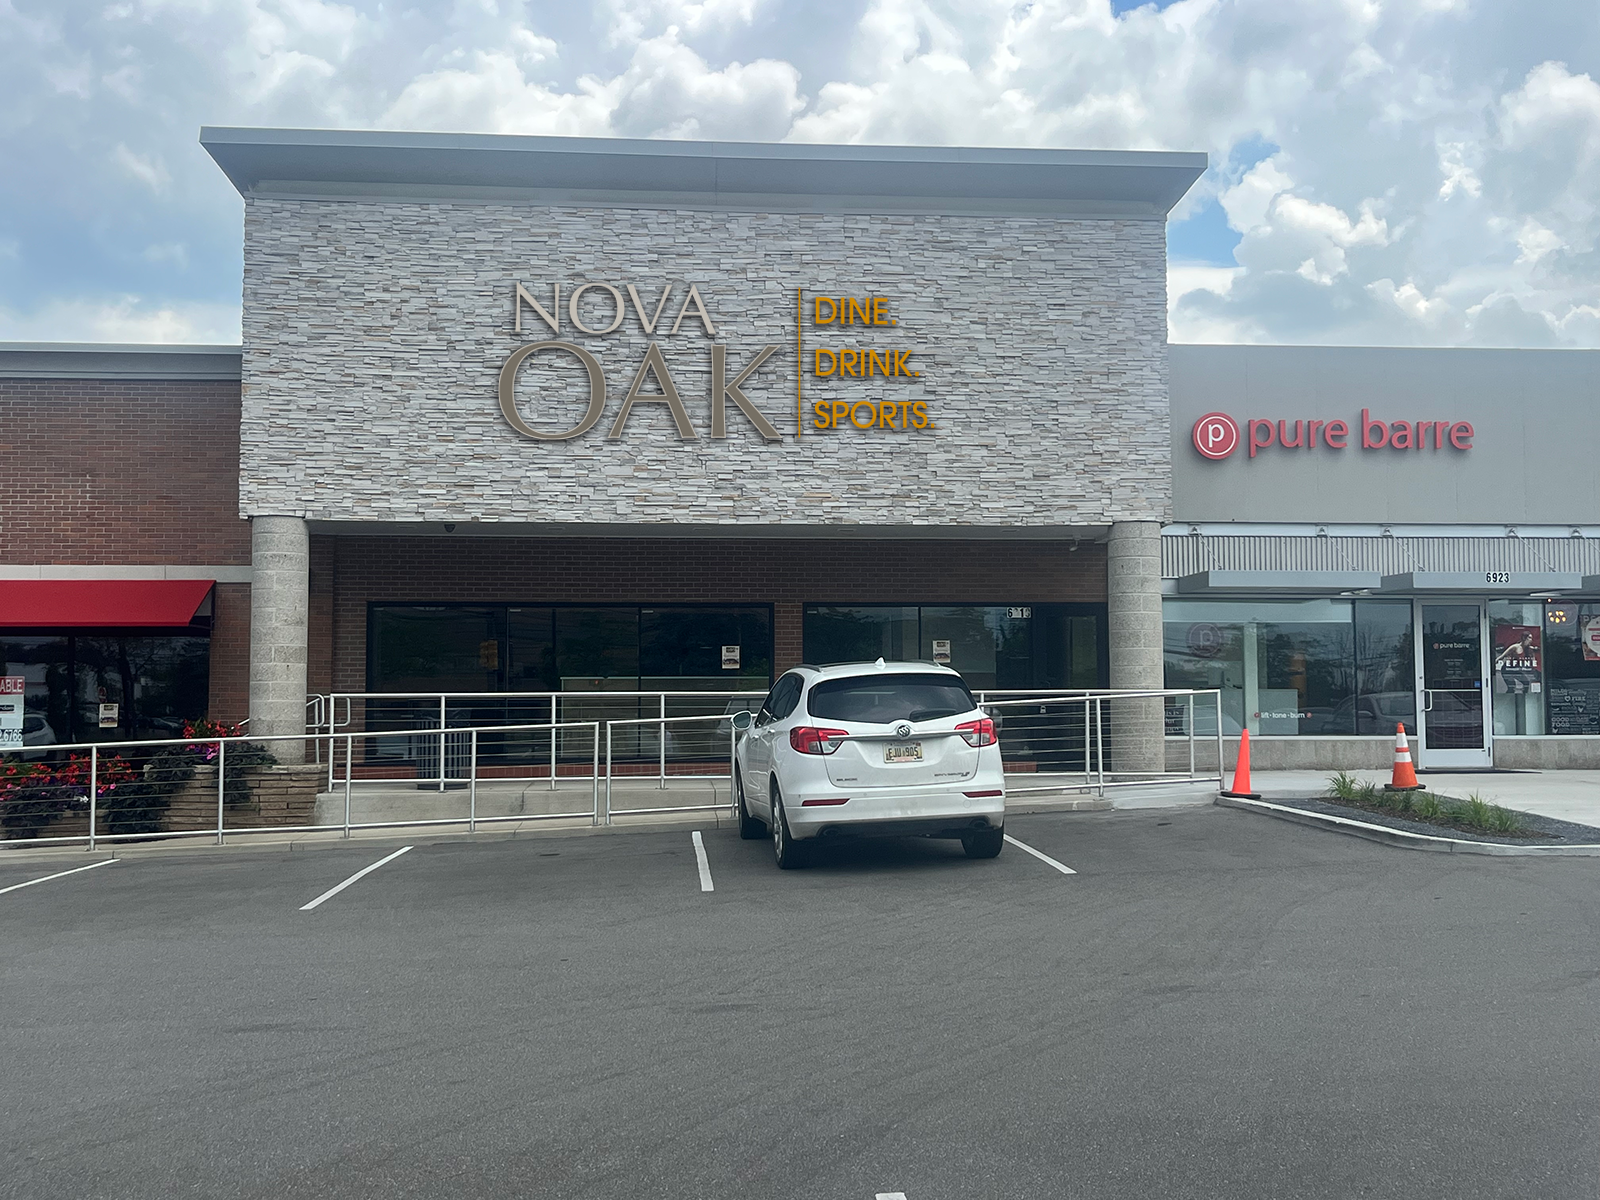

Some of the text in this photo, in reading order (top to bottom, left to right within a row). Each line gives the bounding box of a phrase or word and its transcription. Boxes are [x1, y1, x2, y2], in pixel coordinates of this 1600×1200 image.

[514, 282, 716, 335] NOVA
[814, 297, 898, 326] DINE.
[814, 349, 921, 377] DRINK.
[498, 340, 783, 440] OAK
[813, 401, 936, 430] SPORTS.
[1248, 408, 1475, 458] pure barre
[1485, 572, 1510, 583] 6923
